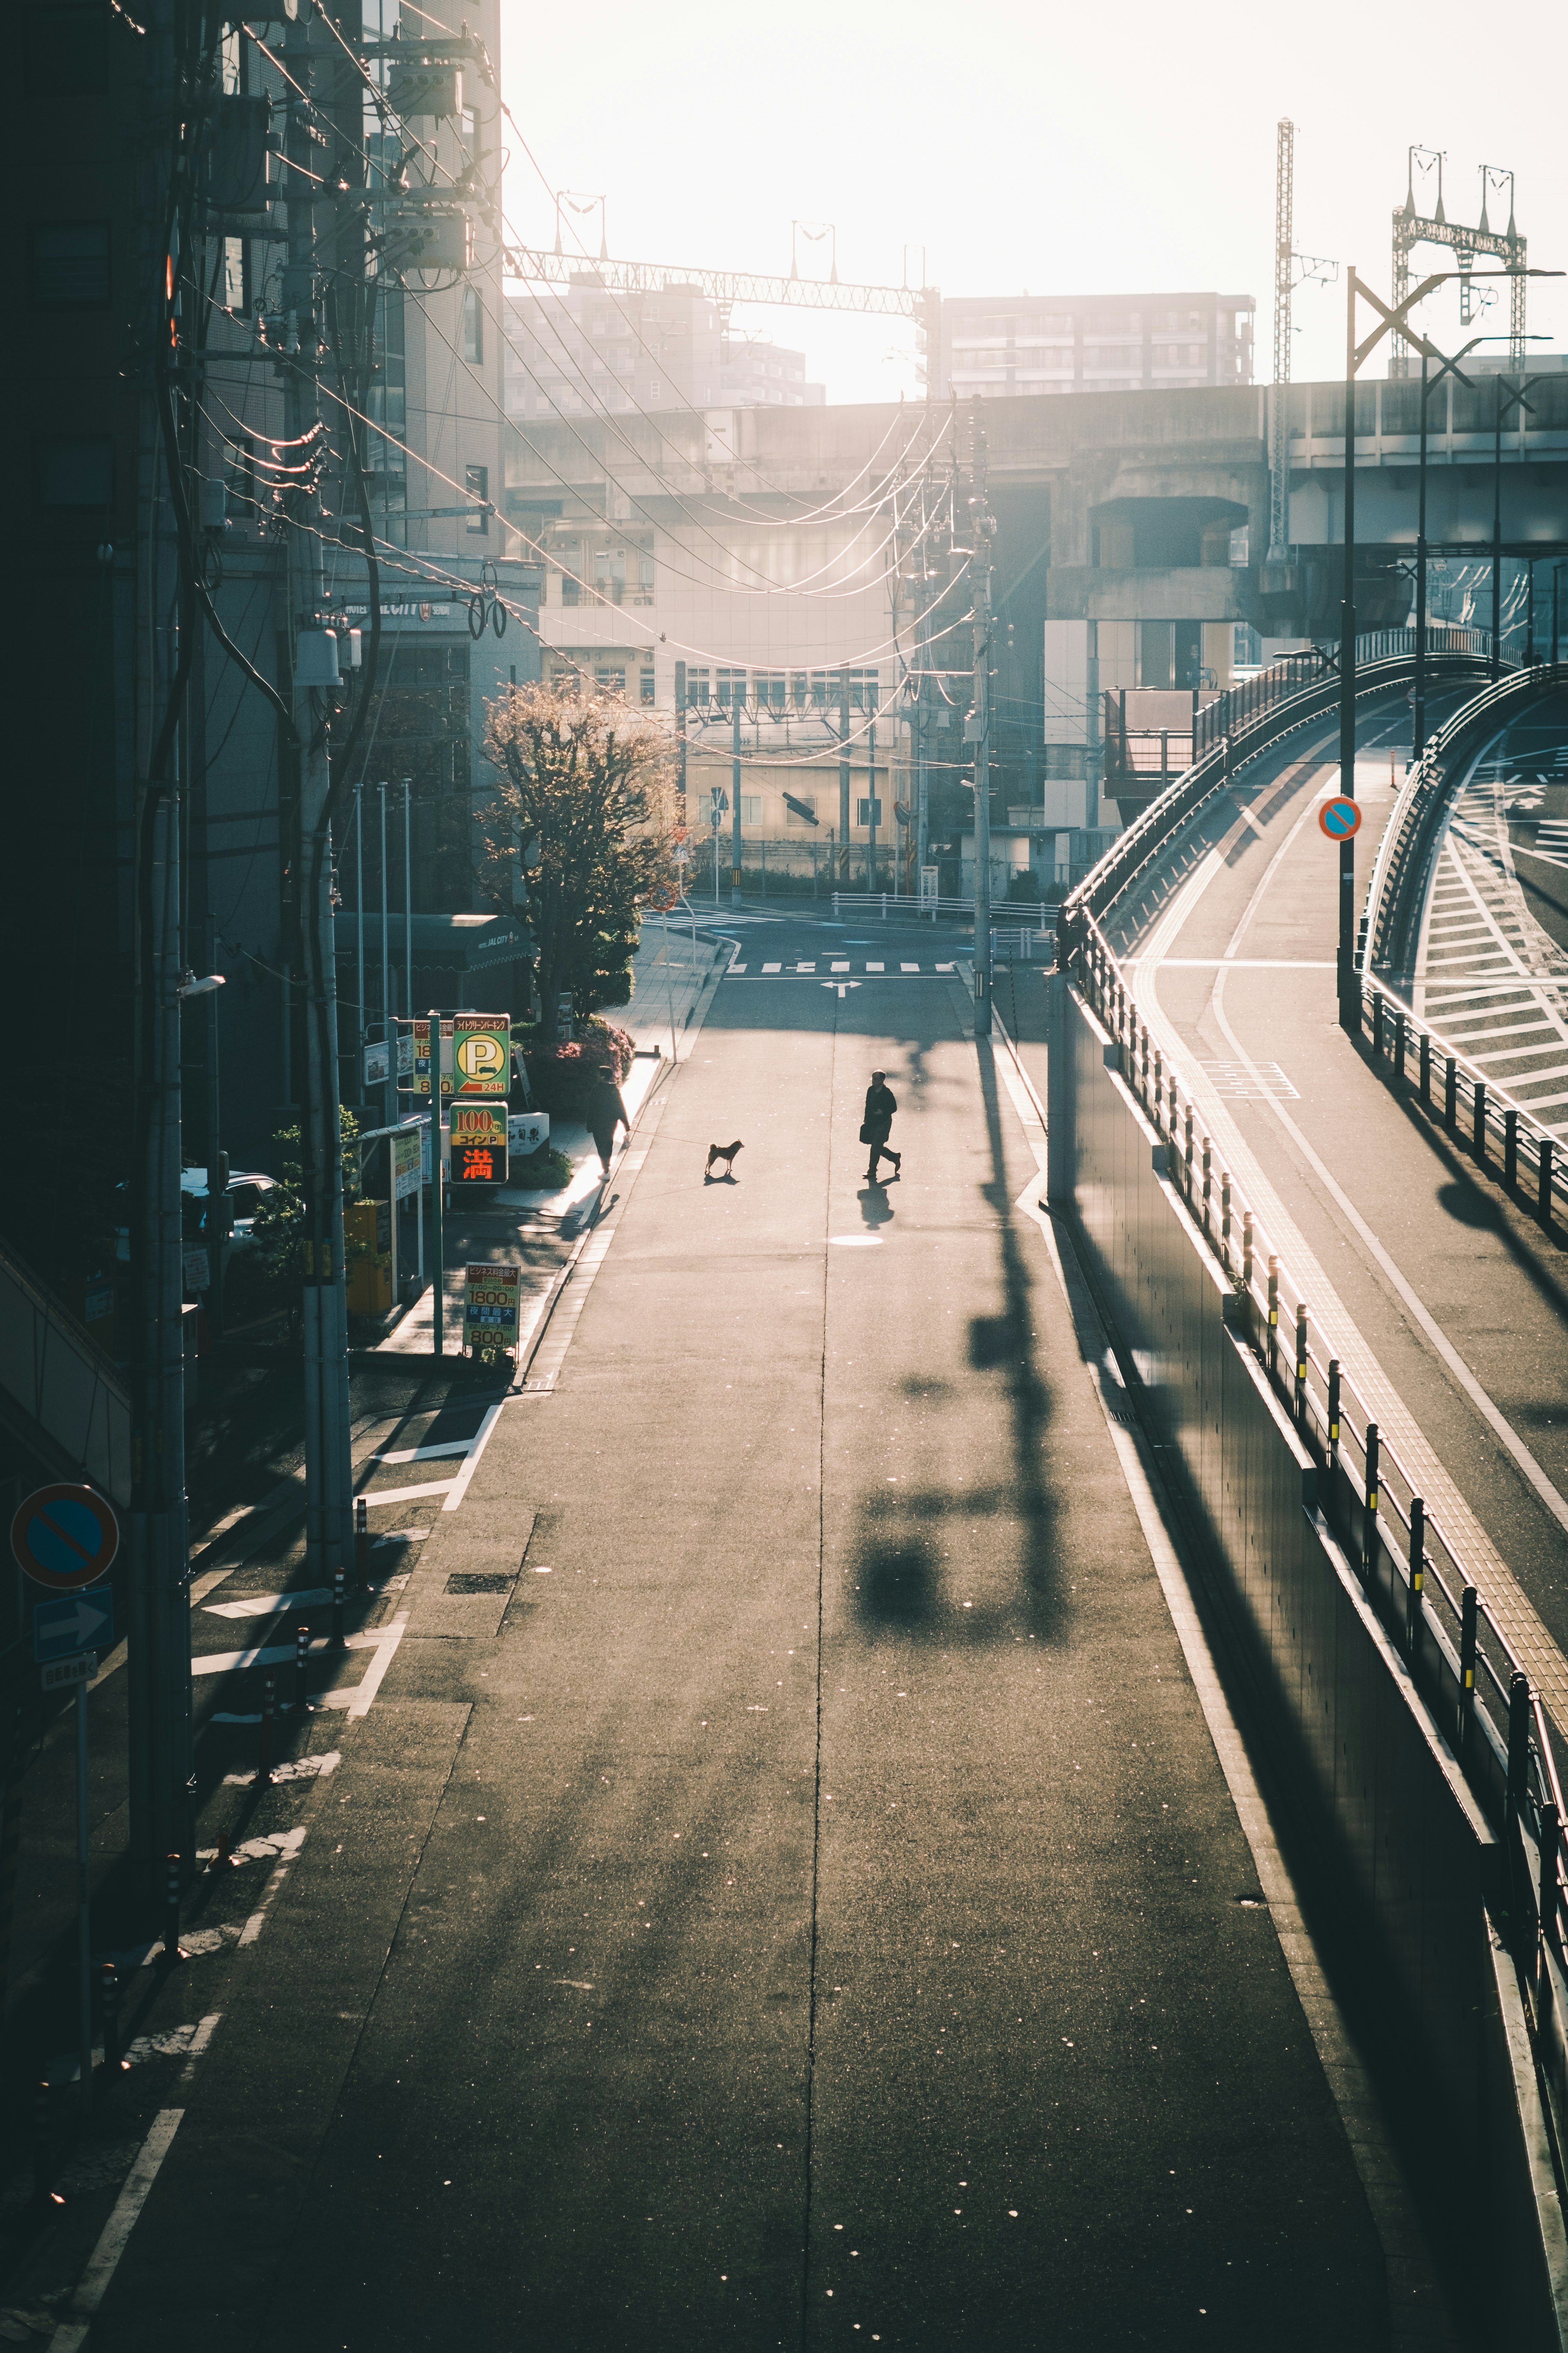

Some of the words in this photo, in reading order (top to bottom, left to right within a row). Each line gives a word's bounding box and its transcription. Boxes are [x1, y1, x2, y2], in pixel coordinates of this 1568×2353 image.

[457, 1020, 505, 1030] ライトグリーンパーキング
[466, 1041, 497, 1075] P
[484, 1083, 504, 1092] 24H
[457, 1110, 492, 1132] 100
[460, 1136, 486, 1144] コイン
[463, 1149, 493, 1179] 満
[470, 1267, 516, 1277] ビジネス料金最大
[469, 1290, 515, 1306] 1800円
[470, 1306, 512, 1317] 夜間最大
[471, 1330, 511, 1345] 800円
[46, 1661, 94, 1685] 自転車を除く
